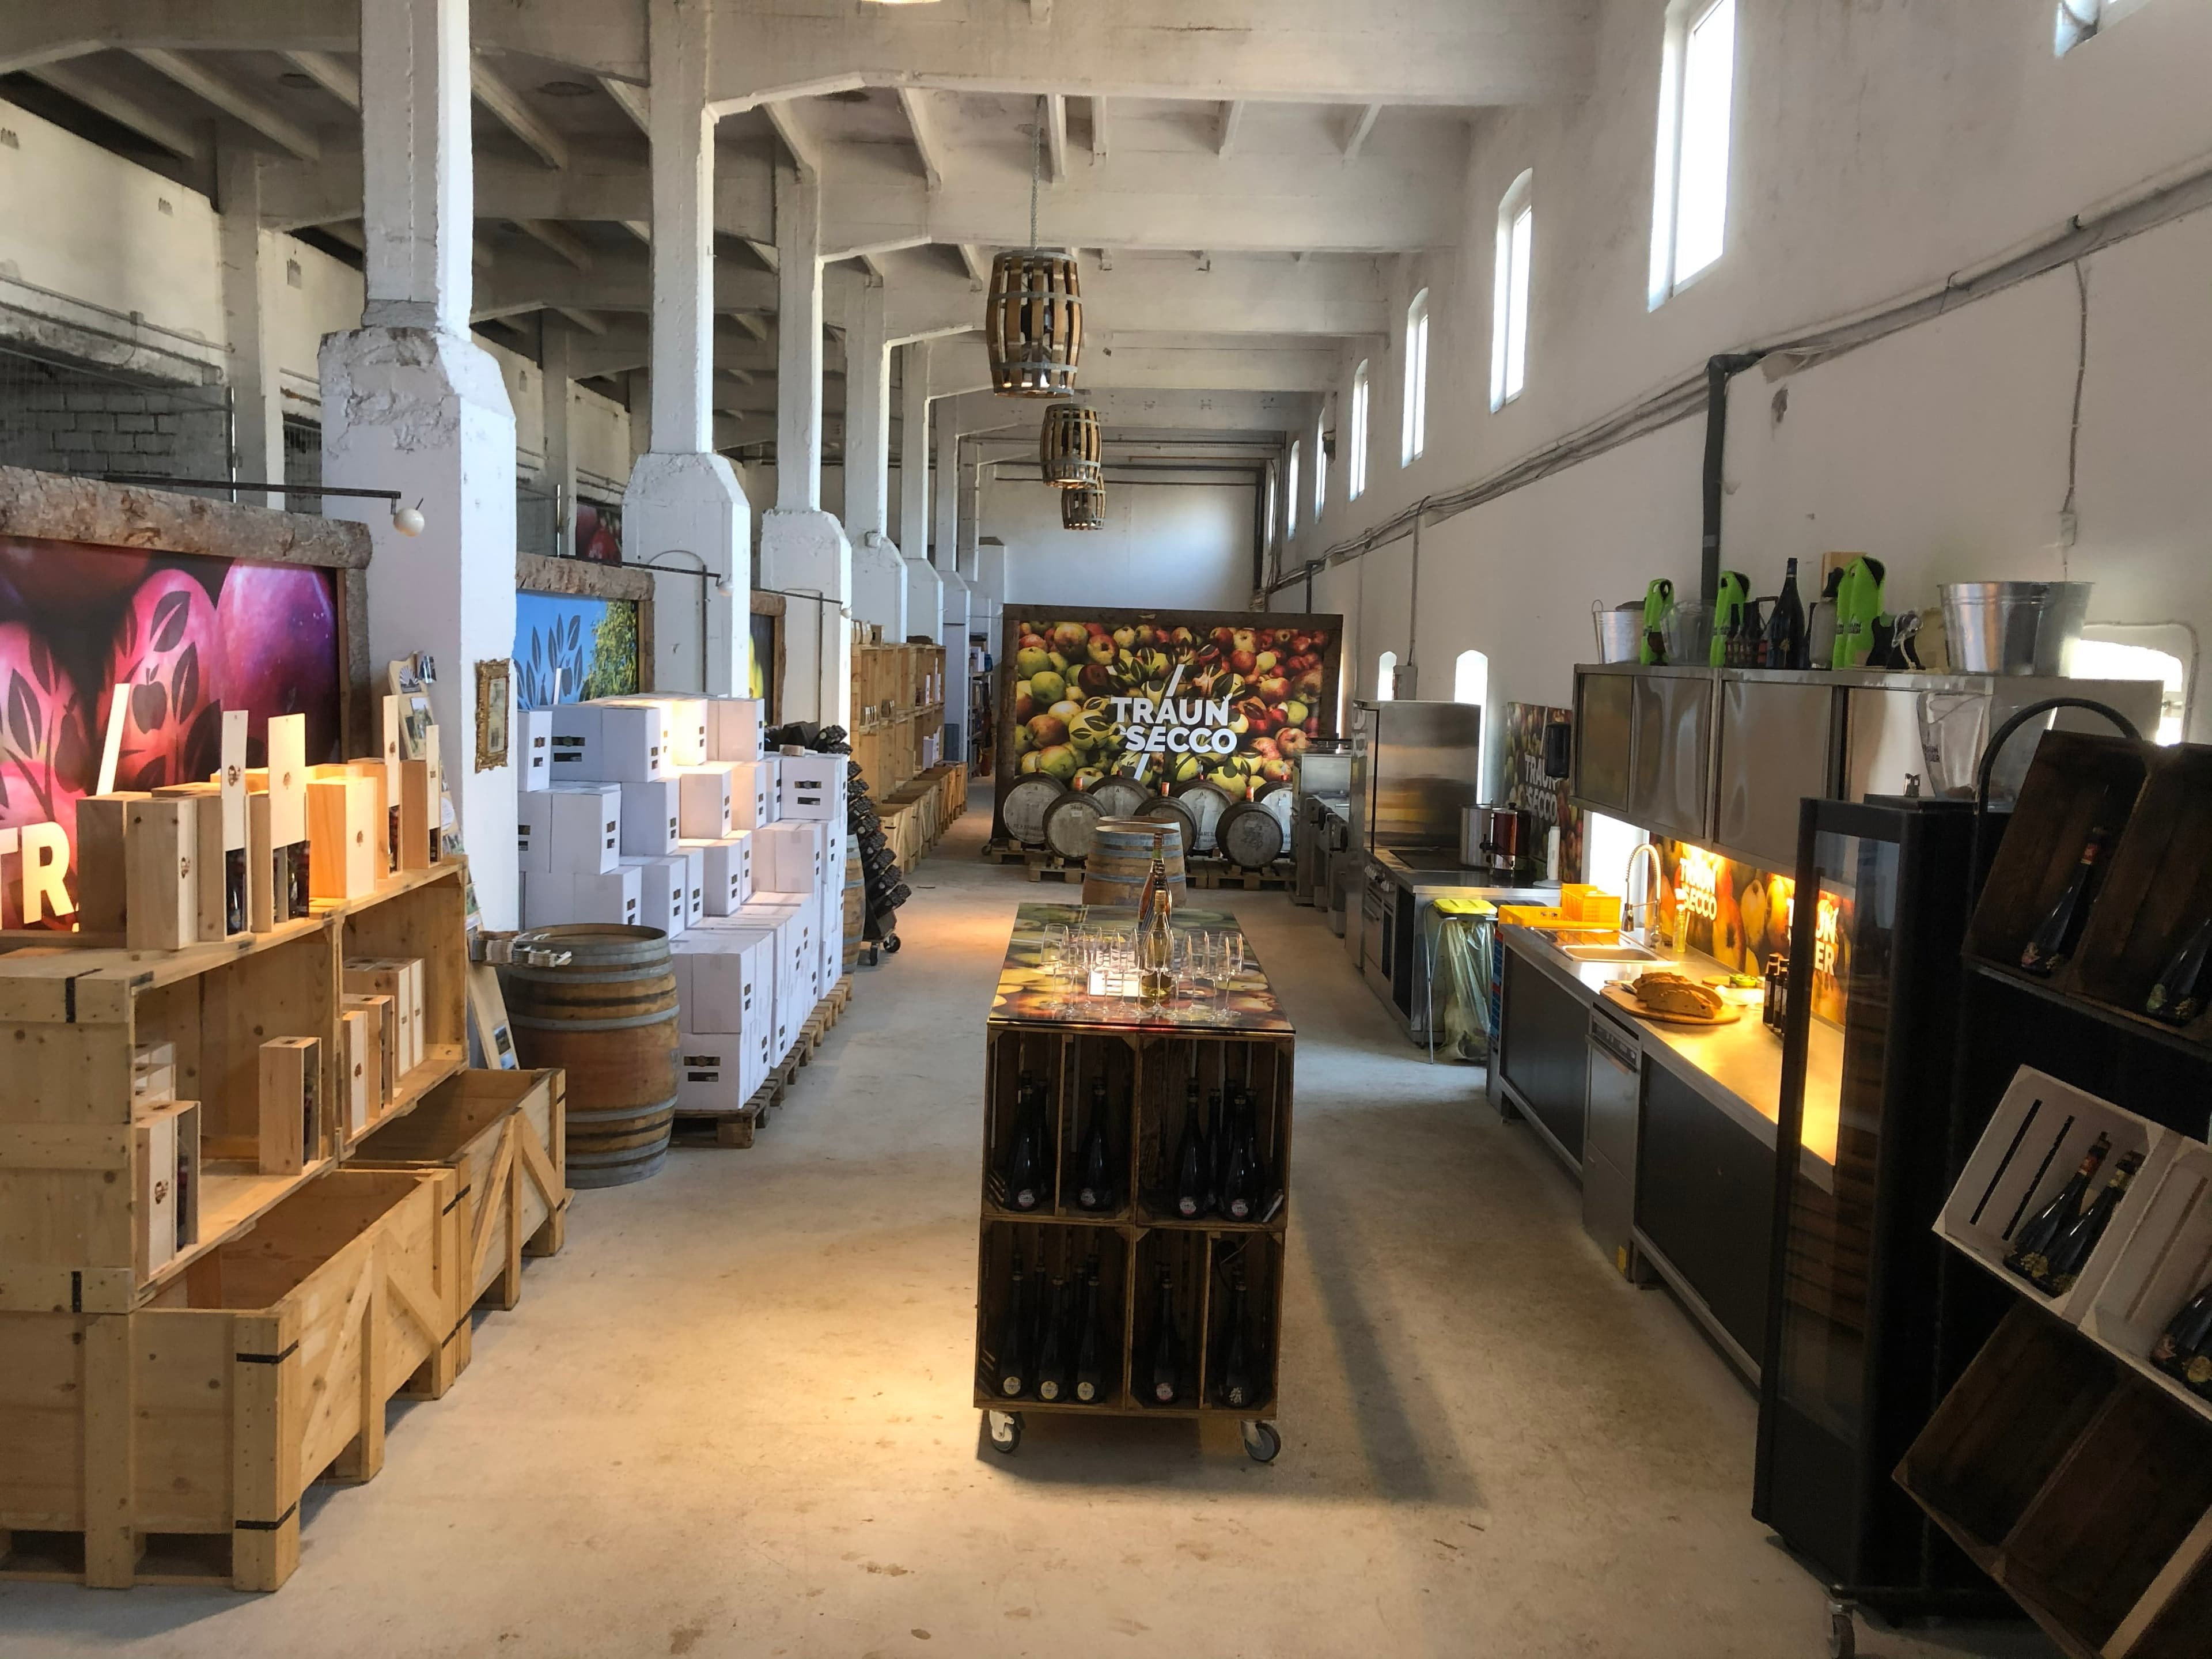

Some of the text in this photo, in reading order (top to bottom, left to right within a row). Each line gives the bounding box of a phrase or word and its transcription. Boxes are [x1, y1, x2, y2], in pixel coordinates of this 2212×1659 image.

[1111, 694, 1230, 726] TRAUN
[1121, 725, 1237, 754] SECCO
[1527, 785, 1558, 823] SECCO
